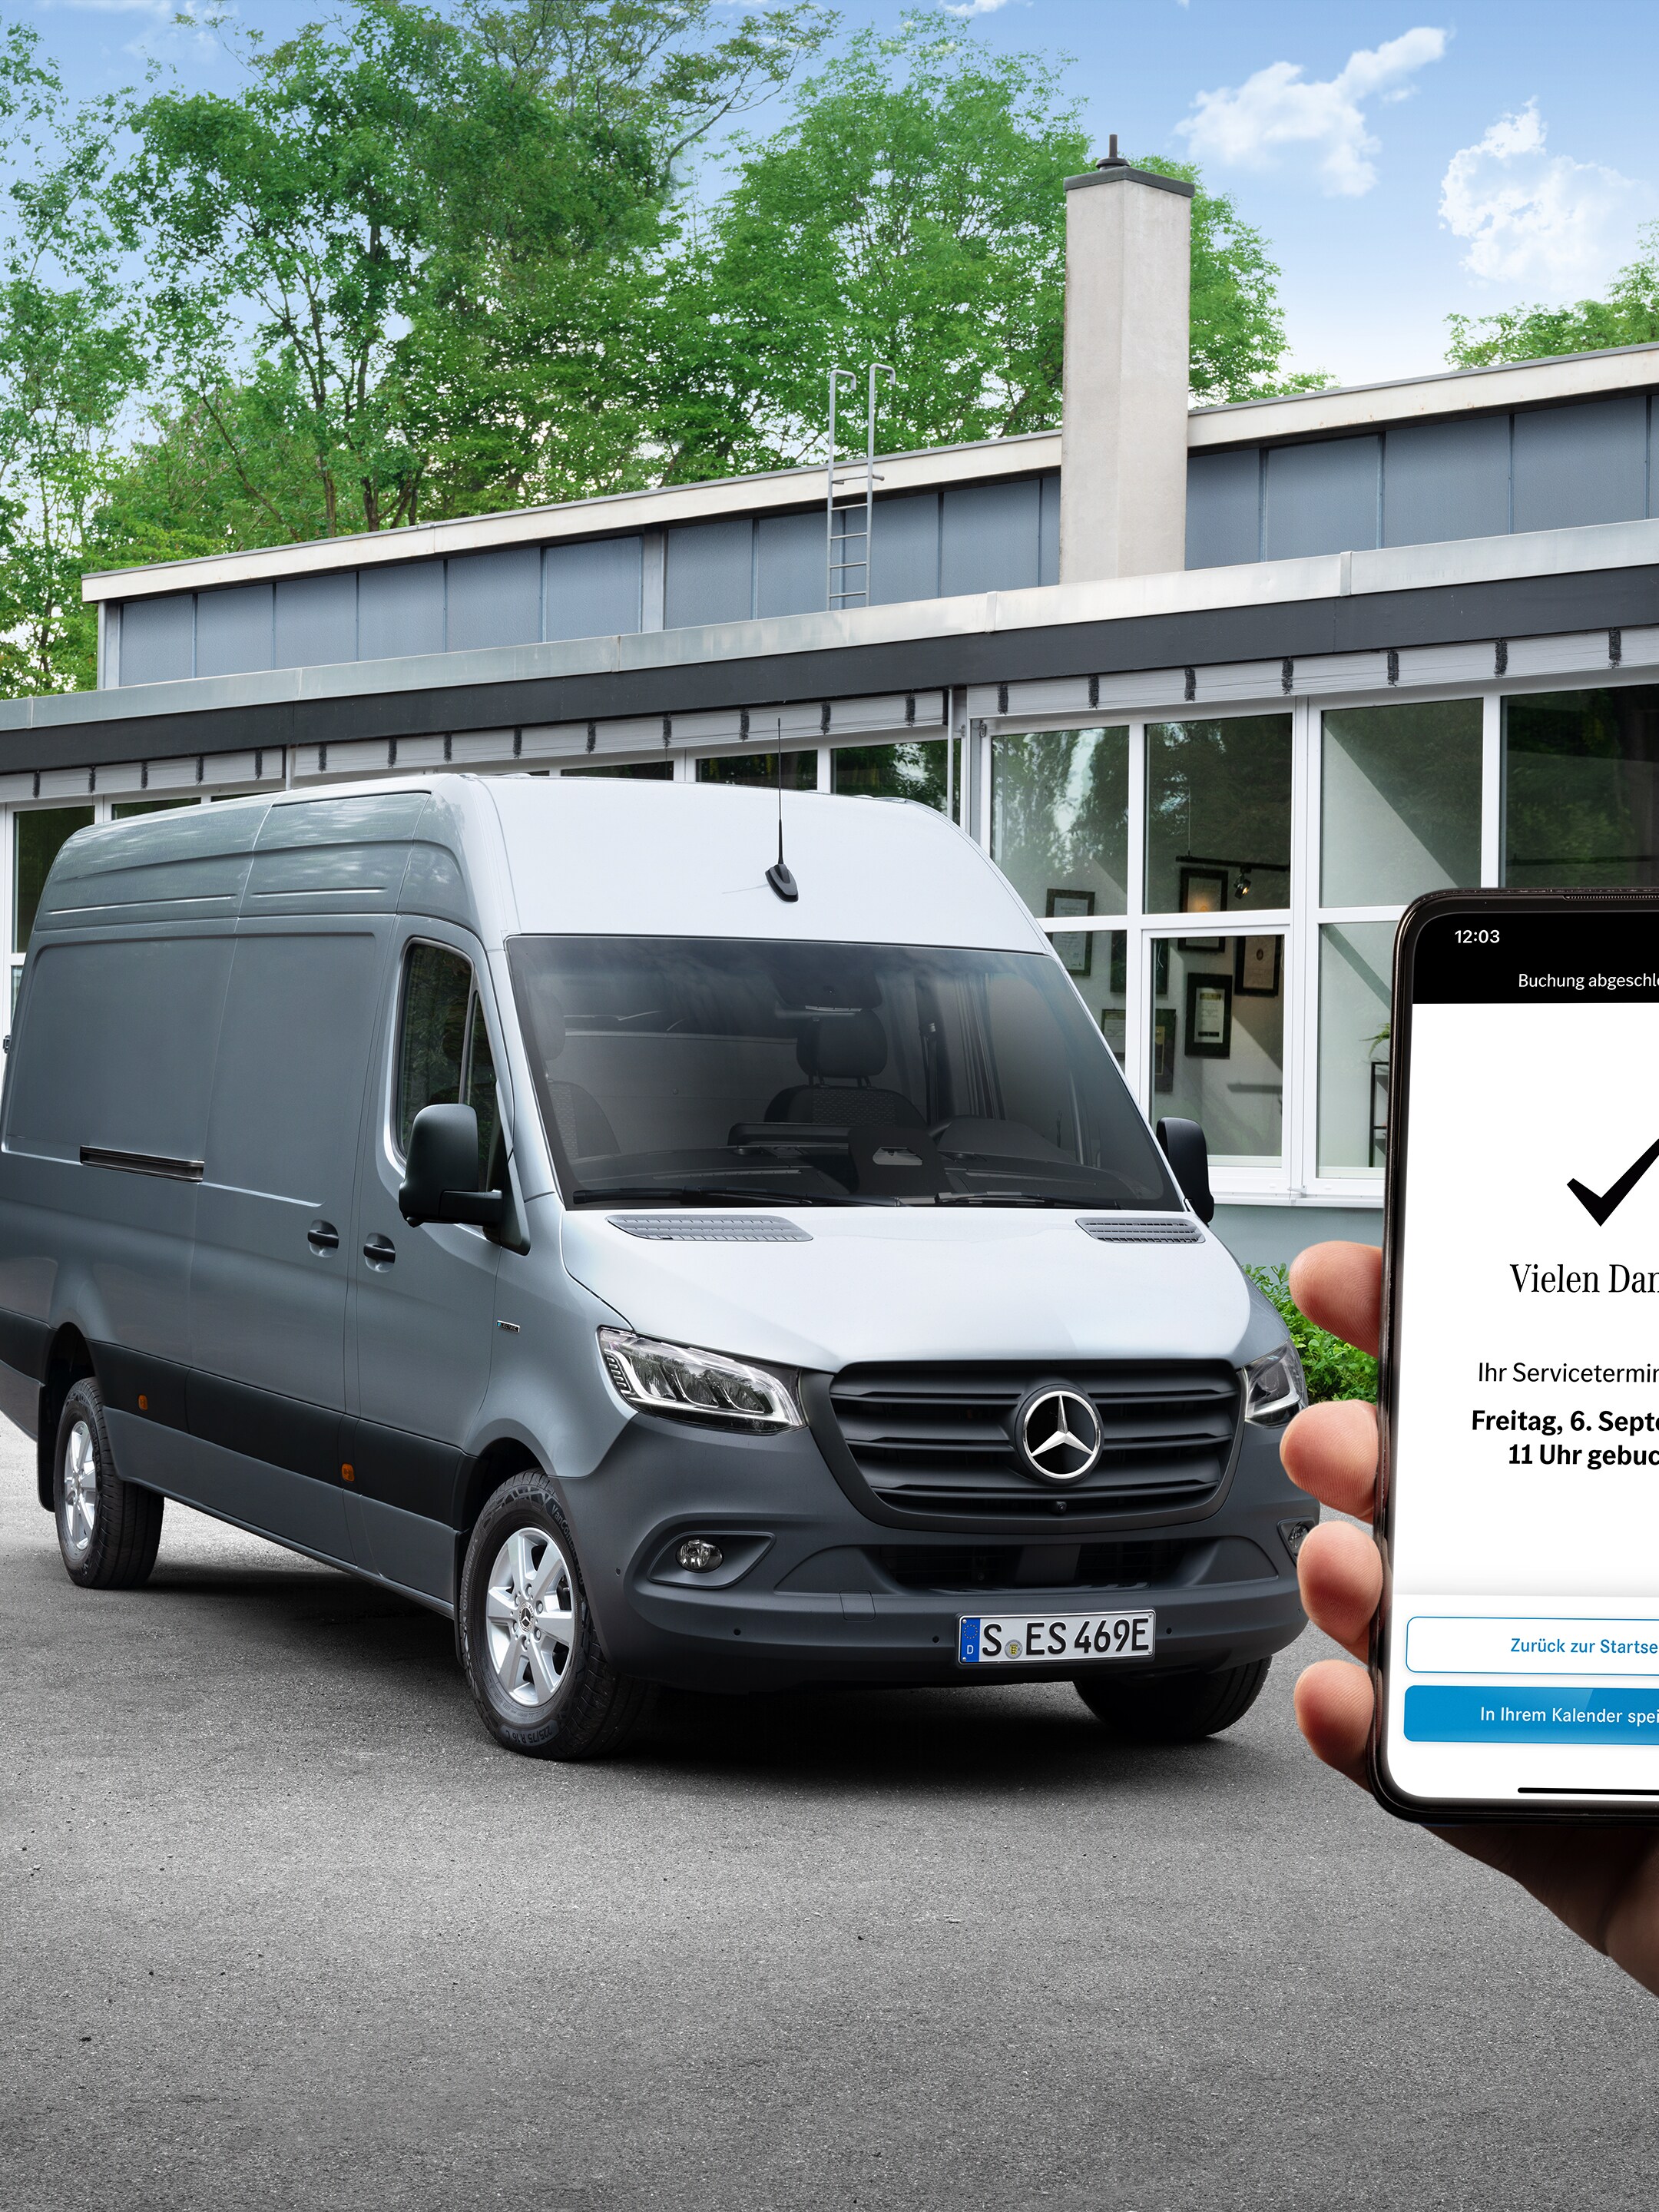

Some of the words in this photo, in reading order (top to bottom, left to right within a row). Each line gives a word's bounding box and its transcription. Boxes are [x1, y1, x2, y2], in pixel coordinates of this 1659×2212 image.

[1455, 929, 1500, 944] 12:03
[1518, 973, 1584, 991] Buchung
[1588, 972, 1659, 991] abgeschl
[1509, 1263, 1601, 1293] Vielen
[1608, 1263, 1659, 1293] Dan
[1479, 1362, 1508, 1382] Ihr
[1472, 1409, 1563, 1436] Freitag,
[1570, 1410, 1592, 1432] 6.
[1598, 1410, 1659, 1436] Sept
[1508, 1443, 1533, 1465] 11
[1539, 1444, 1583, 1465] Uhr
[1587, 1444, 1659, 1470] gebuc
[966, 1644, 974, 1654] D
[982, 1623, 1002, 1657] S
[1026, 1621, 1067, 1656] ES
[1074, 1618, 1149, 1654] 469E
[1511, 1637, 1565, 1653] Zurück
[1570, 1642, 1596, 1653] zur
[1600, 1639, 1659, 1654] Startse
[1481, 1706, 1495, 1721] In
[1501, 1707, 1546, 1722] Ihrem
[1552, 1707, 1622, 1724] Kalender
